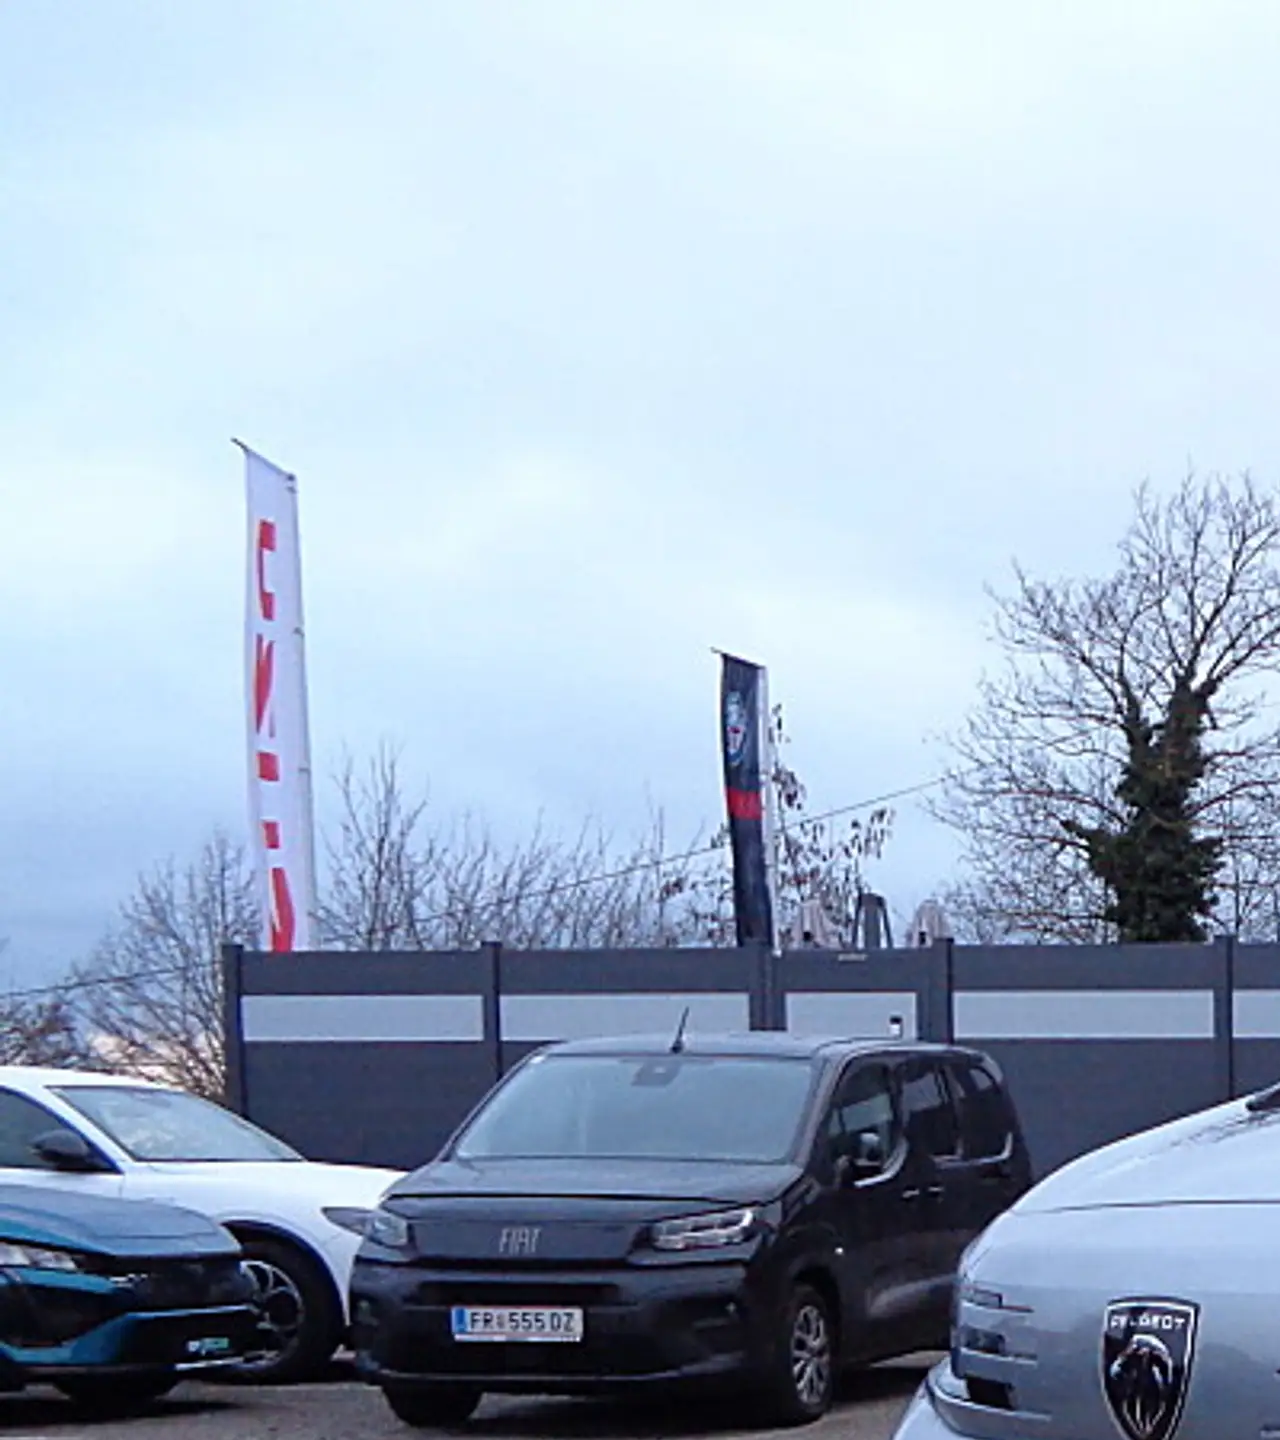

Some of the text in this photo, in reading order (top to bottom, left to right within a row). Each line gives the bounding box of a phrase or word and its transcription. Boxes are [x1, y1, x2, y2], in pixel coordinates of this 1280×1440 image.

[499, 1226, 542, 1255] FIAT
[469, 1312, 494, 1330] FR
[508, 1311, 545, 1331] 555
